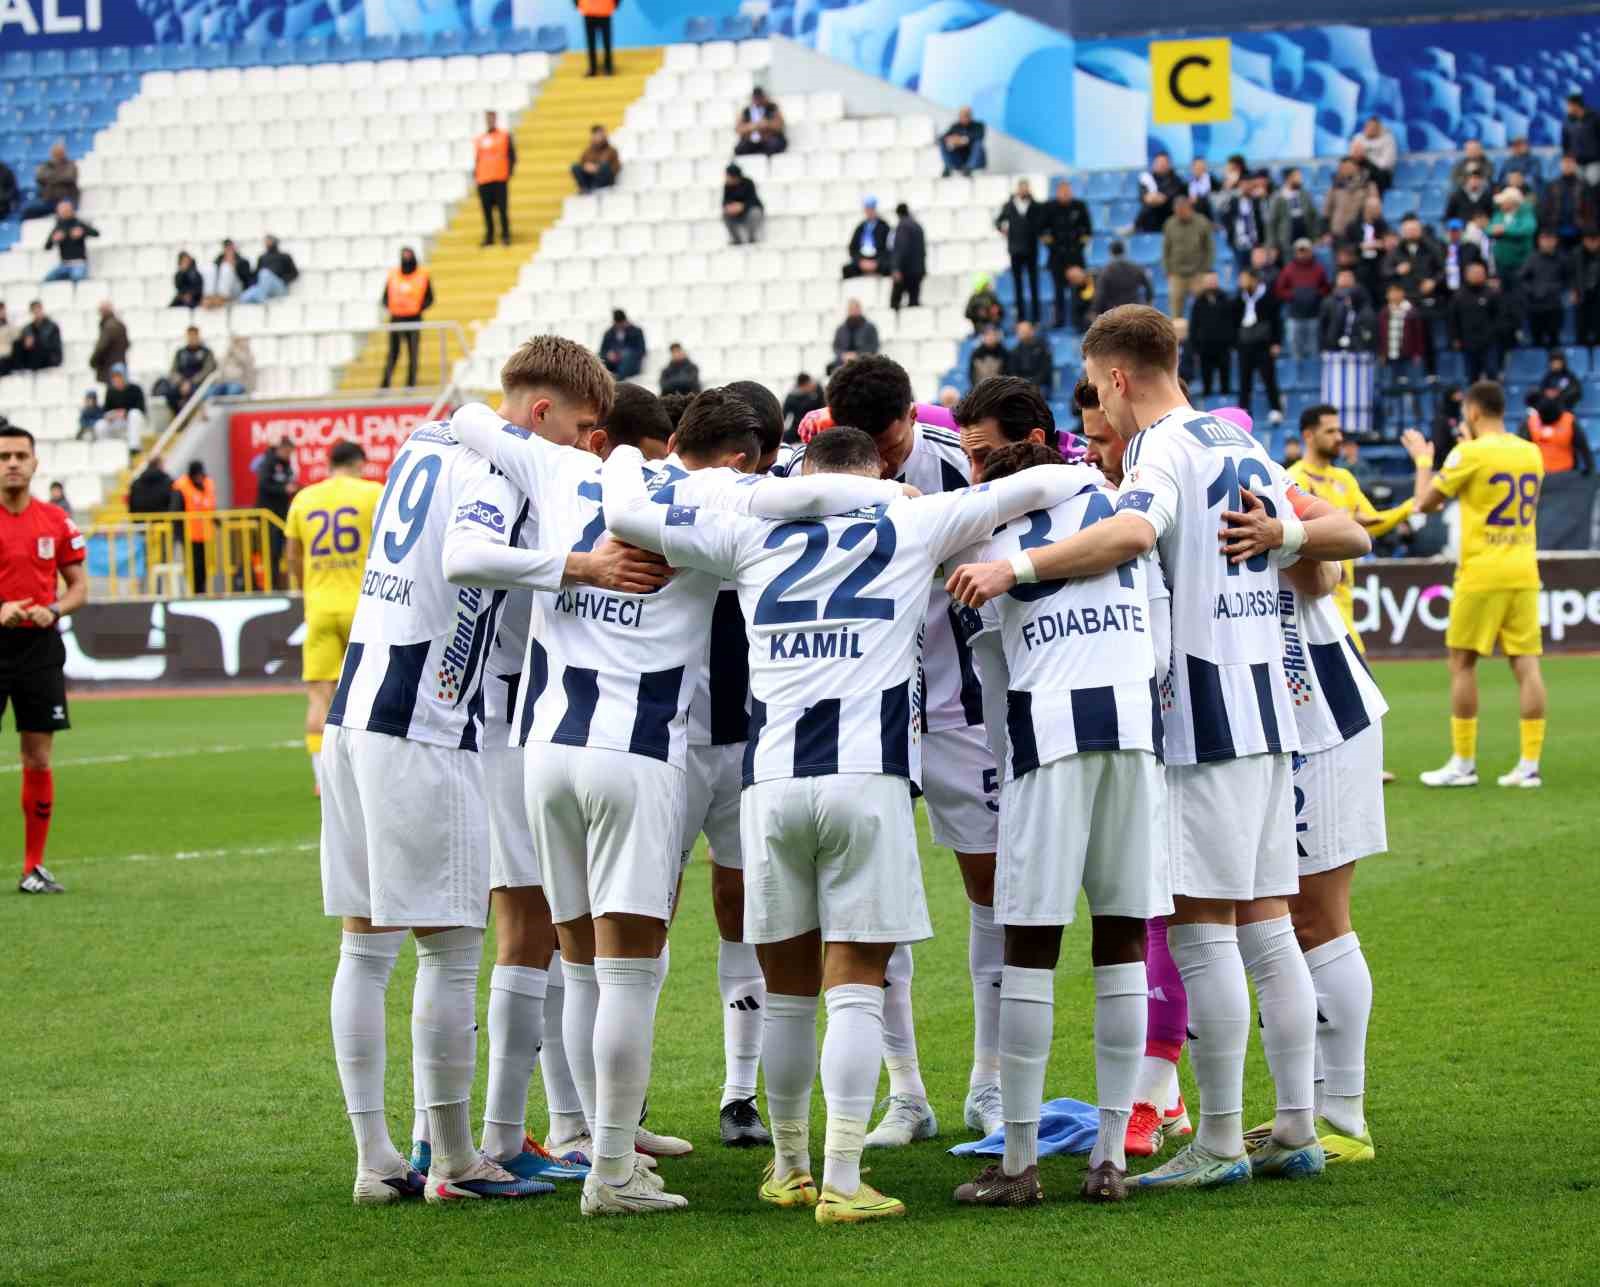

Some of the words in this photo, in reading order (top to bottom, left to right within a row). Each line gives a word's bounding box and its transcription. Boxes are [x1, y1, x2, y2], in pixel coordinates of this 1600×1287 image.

[1169, 55, 1212, 109] C
[367, 450, 442, 564] 19
[1486, 472, 1538, 527] 28
[306, 507, 361, 557] 26
[753, 515, 897, 626] 22
[443, 610, 476, 671] Rent
[769, 626, 864, 660] KAMİL
[1022, 604, 1145, 651] F.DIABATE
